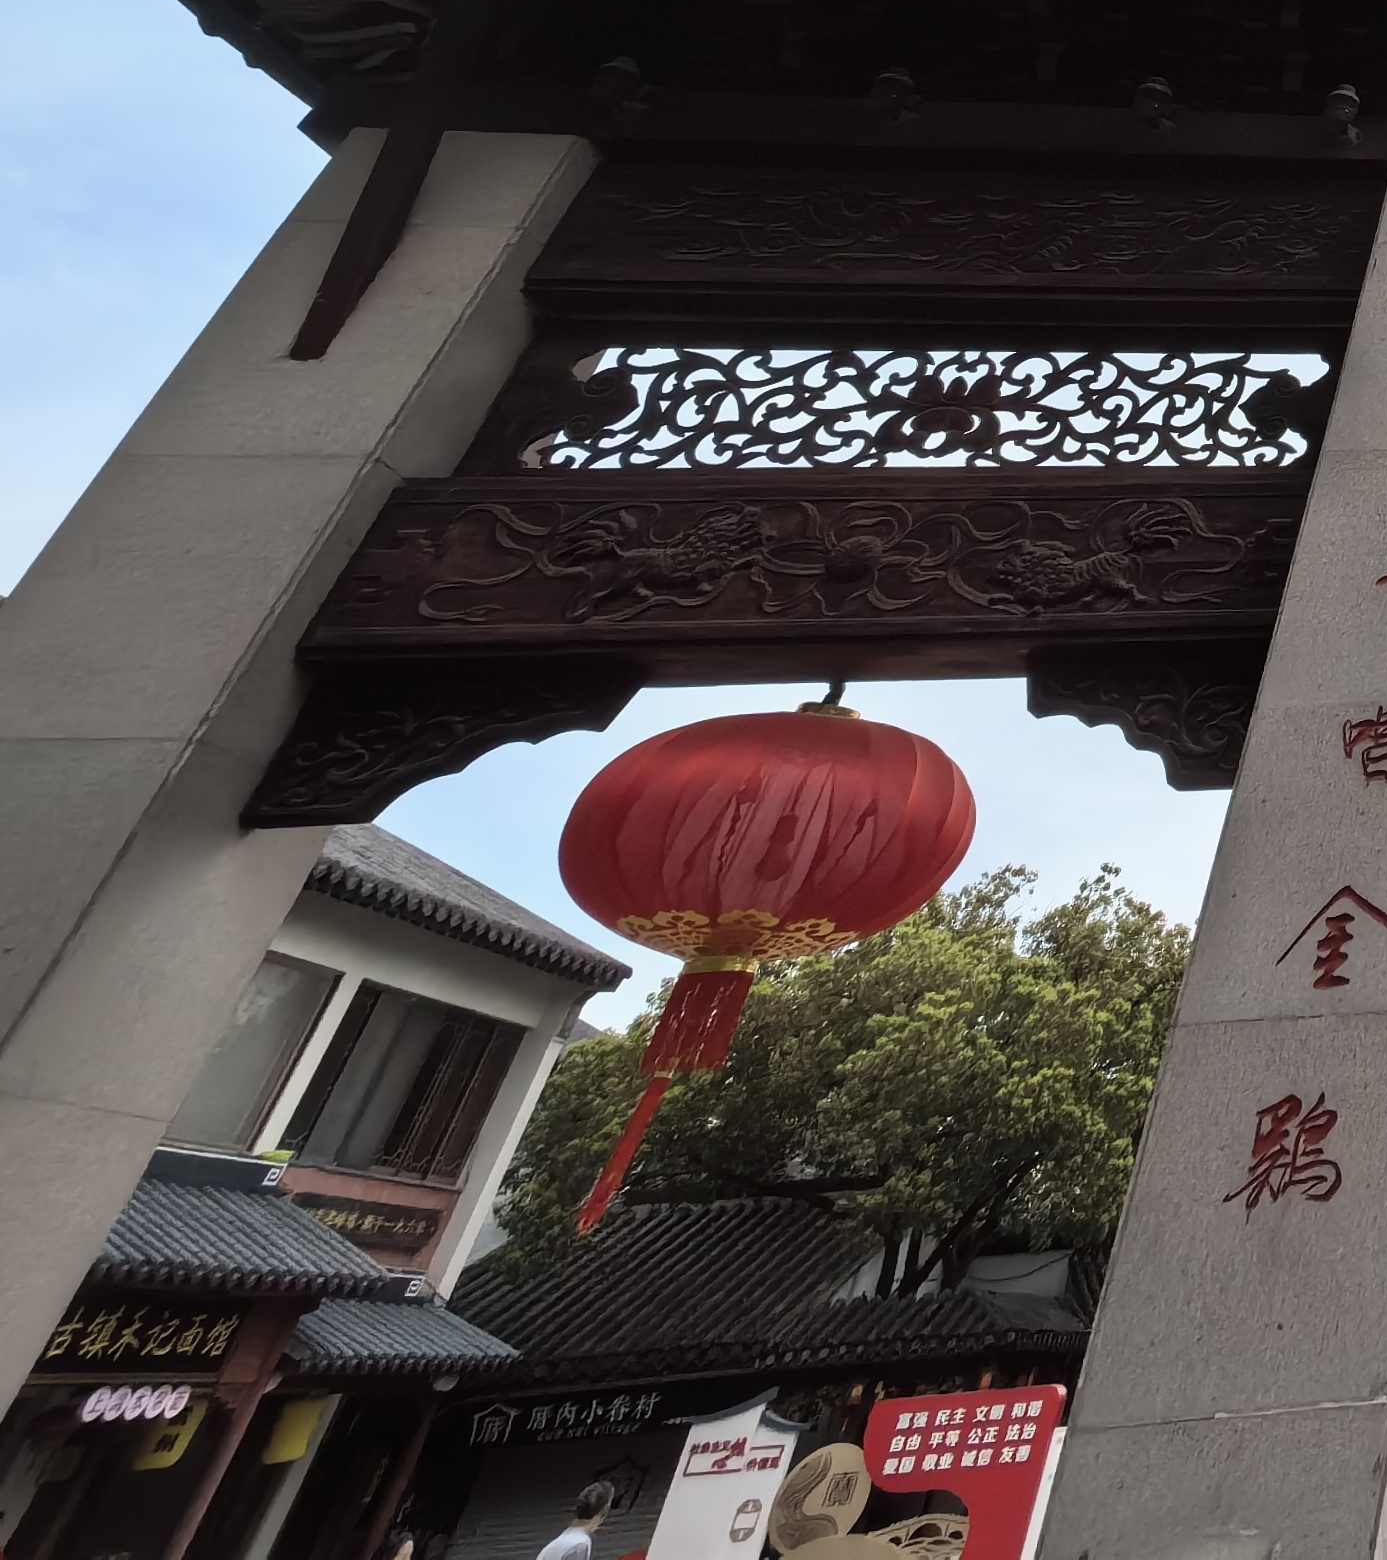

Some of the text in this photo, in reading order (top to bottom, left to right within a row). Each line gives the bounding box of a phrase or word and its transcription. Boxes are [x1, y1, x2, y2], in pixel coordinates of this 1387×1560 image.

[895, 1400, 1044, 1431] 富强 民主 文明 和谐
[889, 1423, 1037, 1453] 自由 平等 公正 法治
[882, 1445, 1032, 1476] 爱国 敬业 诚信 友善
